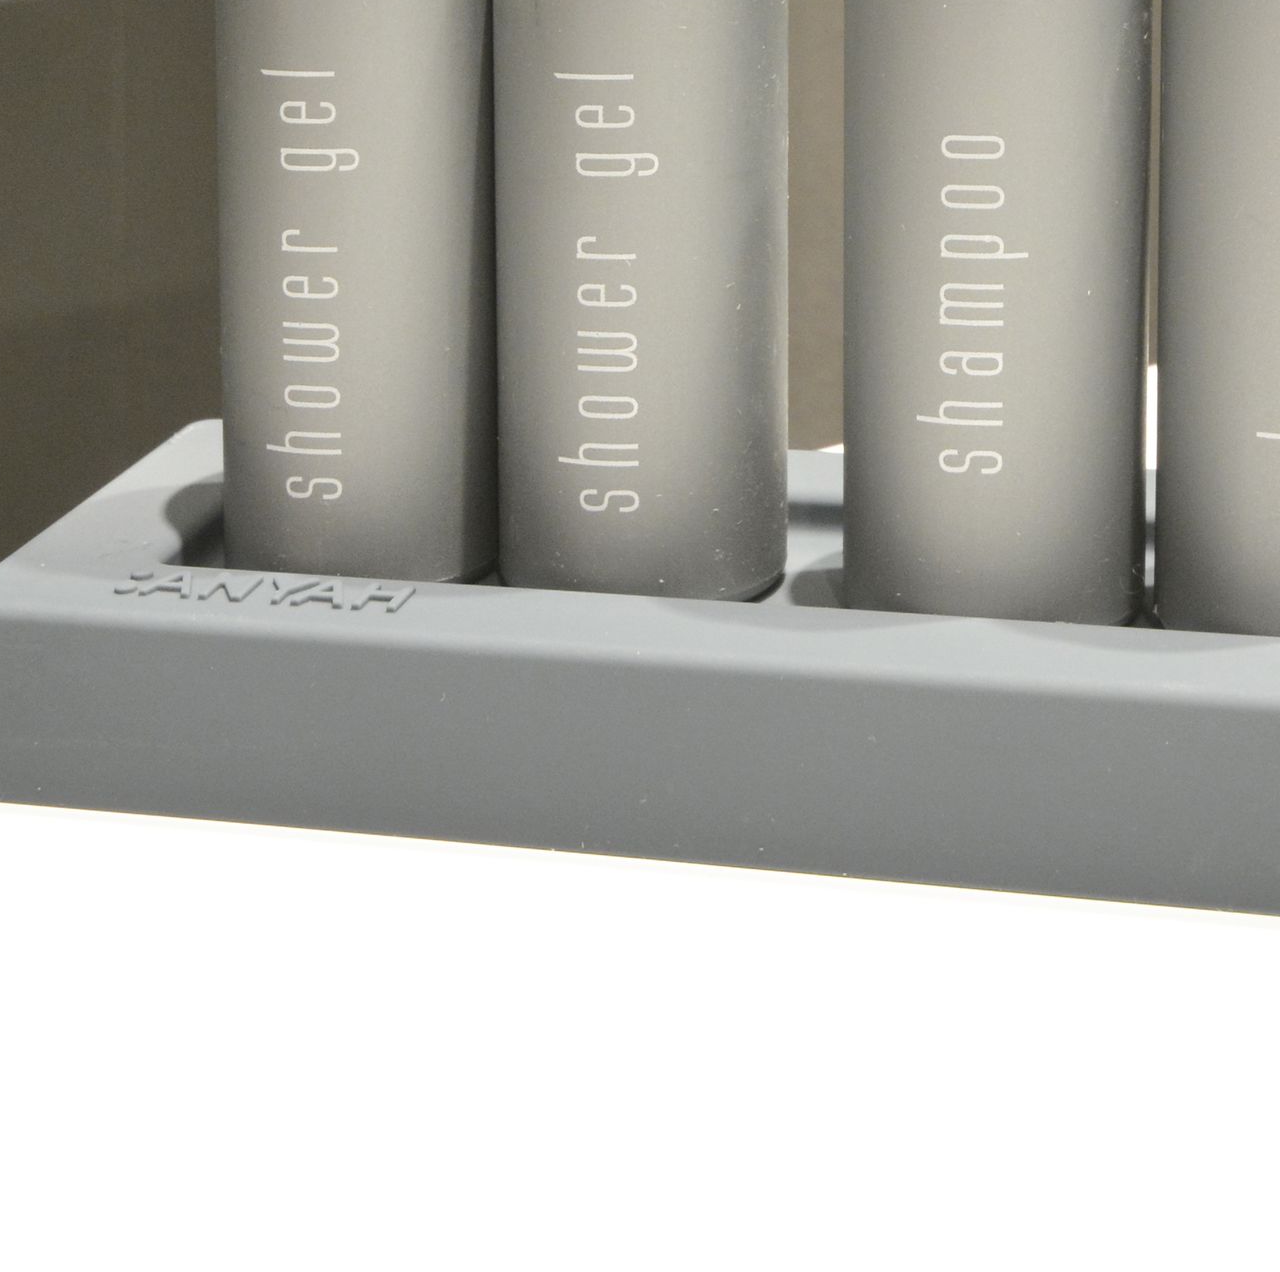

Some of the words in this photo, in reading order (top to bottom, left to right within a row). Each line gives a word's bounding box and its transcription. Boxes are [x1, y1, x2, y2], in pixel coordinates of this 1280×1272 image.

[260, 68, 360, 173] gel
[553, 71, 660, 178] gel
[265, 228, 343, 501] shower
[558, 235, 640, 514] shower
[916, 134, 1029, 476] shampoo
